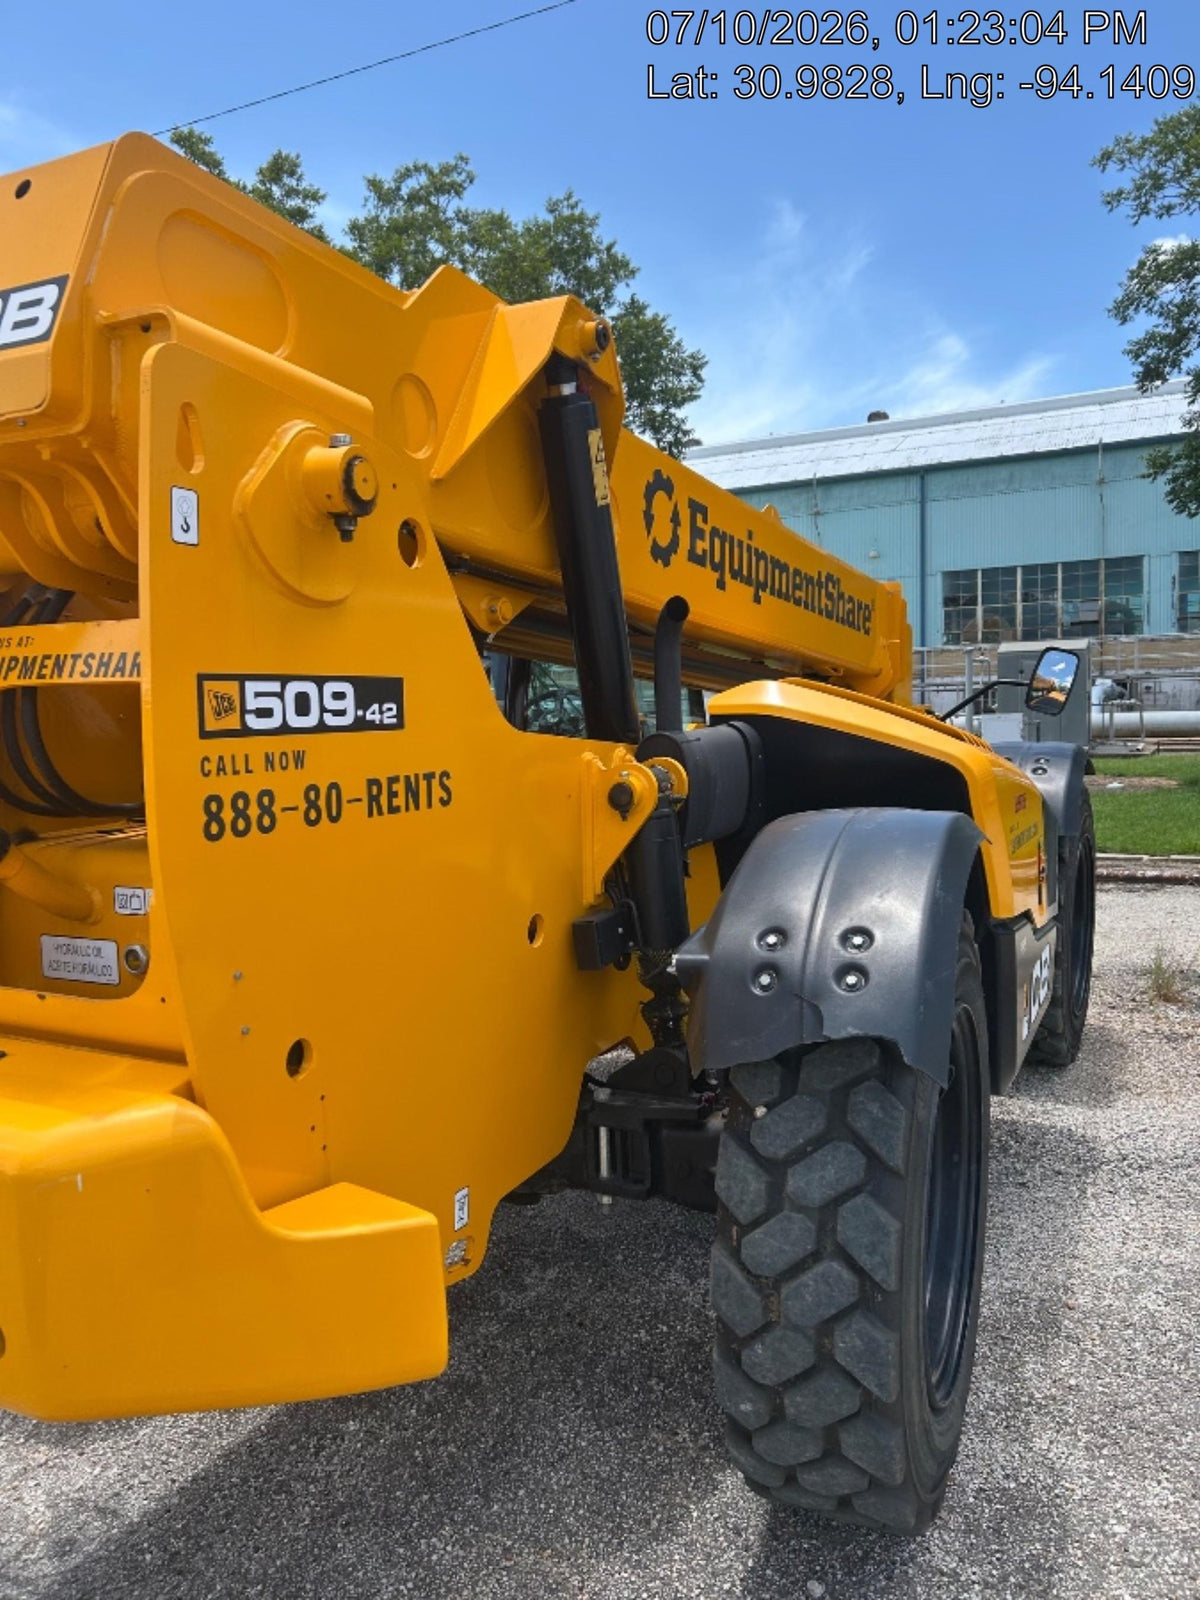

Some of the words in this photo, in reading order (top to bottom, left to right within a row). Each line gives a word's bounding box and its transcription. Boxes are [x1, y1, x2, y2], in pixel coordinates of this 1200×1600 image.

[687, 497, 872, 636] EquipmentShare
[200, 755, 253, 777] CALL
[264, 750, 306, 772] NOW
[203, 770, 452, 842] 888-80-RENTS
